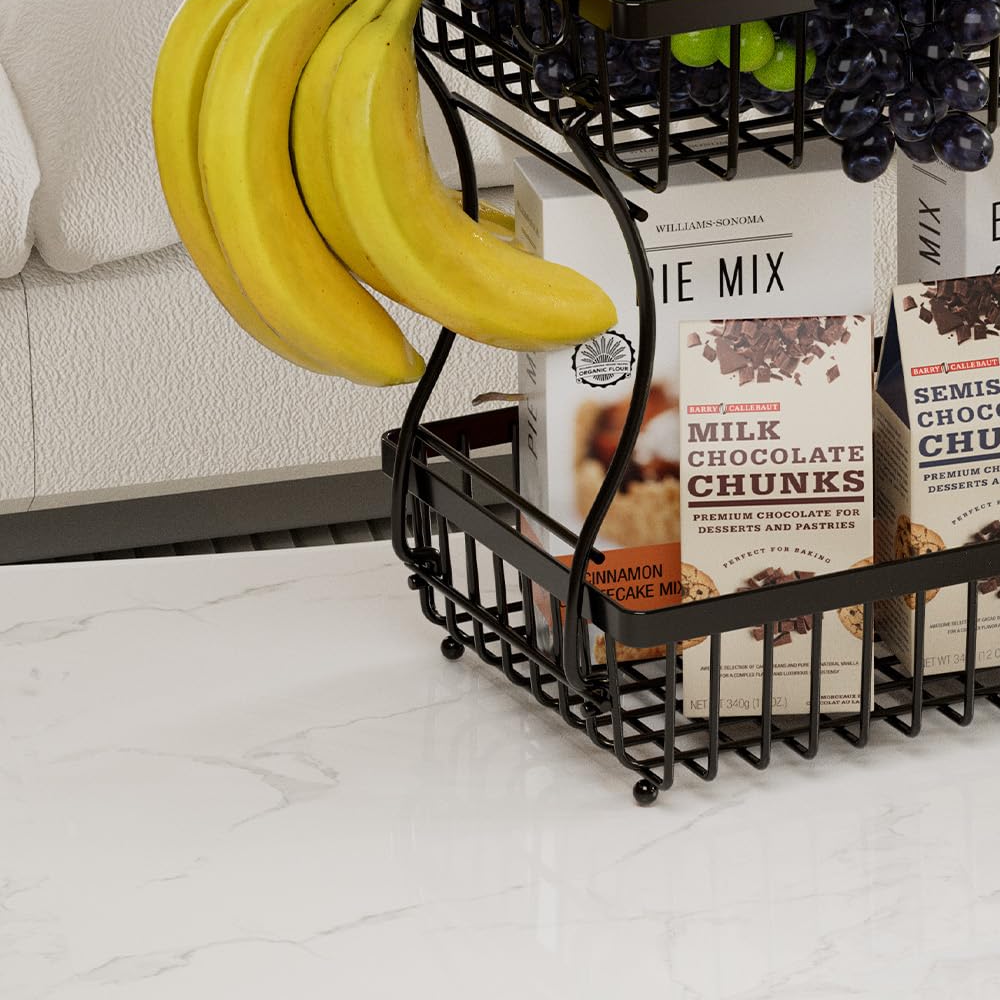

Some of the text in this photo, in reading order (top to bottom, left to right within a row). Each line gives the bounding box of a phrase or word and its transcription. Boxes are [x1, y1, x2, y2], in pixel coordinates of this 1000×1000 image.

[918, 197, 941, 266] MIX
[636, 251, 785, 306] IE MIX
[578, 367, 607, 376] ORGANIC
[912, 359, 998, 375] BARRY CALLEBAUT
[689, 403, 779, 413] BARRY CALLEBAUT
[687, 420, 780, 443] MILK
[687, 446, 864, 468] CHOCOLATE
[923, 467, 980, 481] PREMIUM
[687, 470, 864, 498] CHUNKS
[928, 479, 988, 493] DESSERTS
[693, 508, 860, 522] PREMIUM CHOCOLATE FOR
[951, 502, 992, 526] PERFECT
[698, 521, 855, 534] DESSERTS AND PASTRIES
[722, 548, 766, 569] PERFECT
[794, 547, 831, 564] BAKING
[938, 655, 951, 666] WT
[690, 700, 708, 710] NET
[727, 698, 750, 710] 340g
